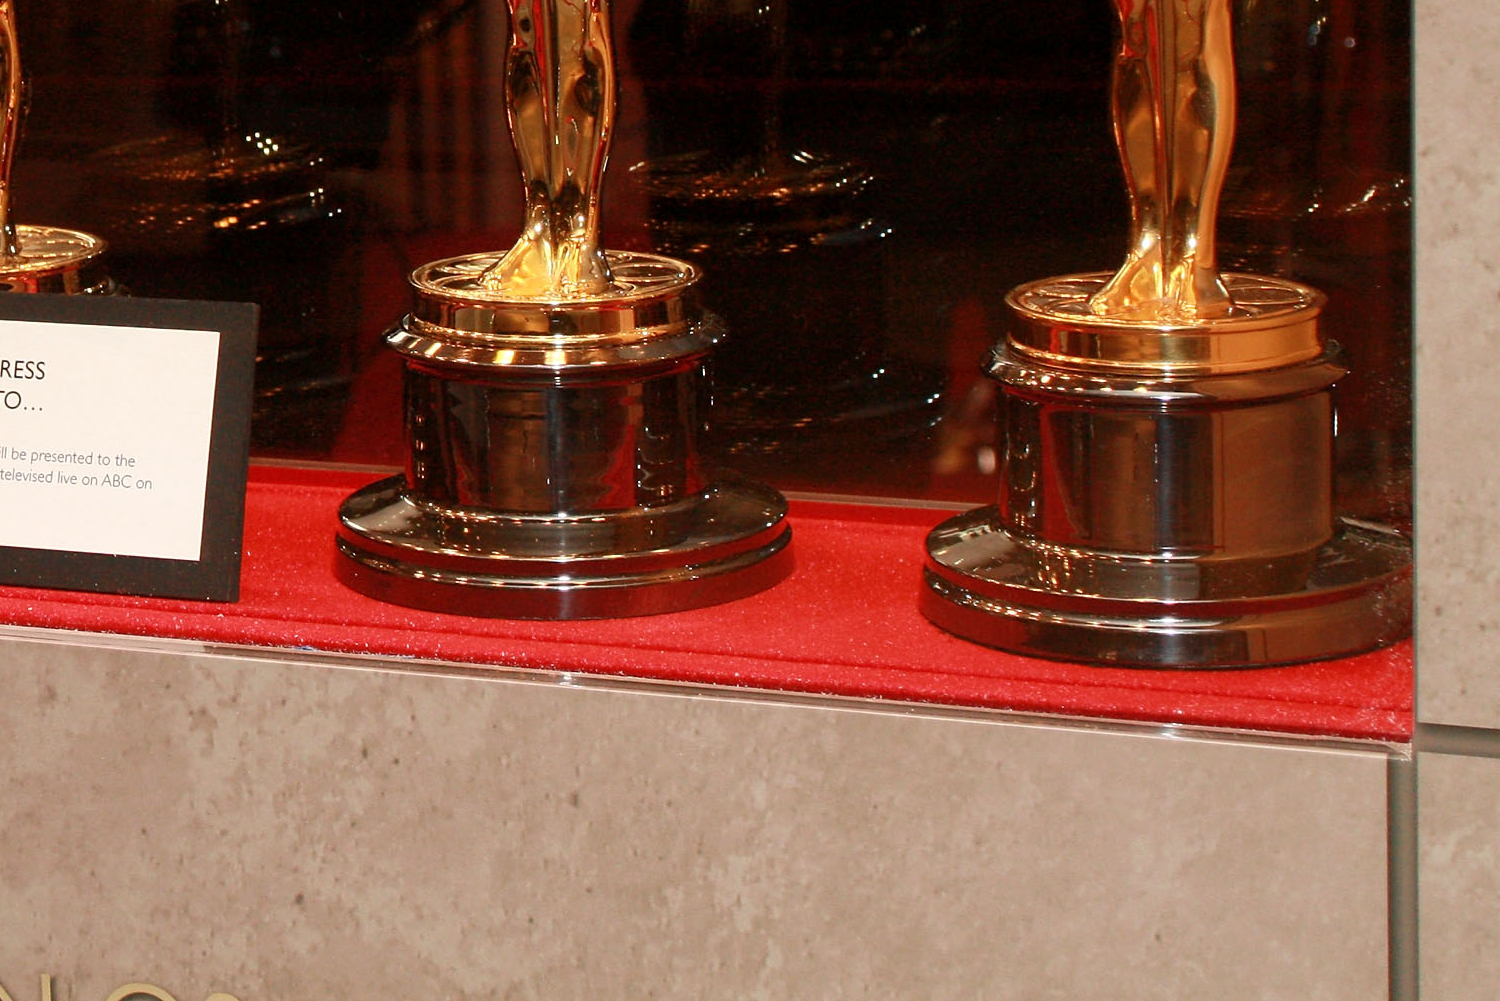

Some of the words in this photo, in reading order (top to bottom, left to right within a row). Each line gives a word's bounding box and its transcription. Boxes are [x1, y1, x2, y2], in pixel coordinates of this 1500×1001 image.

[10, 446, 27, 461] be
[30, 451, 94, 465] presented
[97, 453, 111, 466] to
[114, 453, 136, 468] the
[0, 467, 54, 484] televised
[57, 470, 78, 485] live
[81, 475, 98, 487] on
[100, 473, 133, 489] ABC
[135, 479, 153, 490] on
